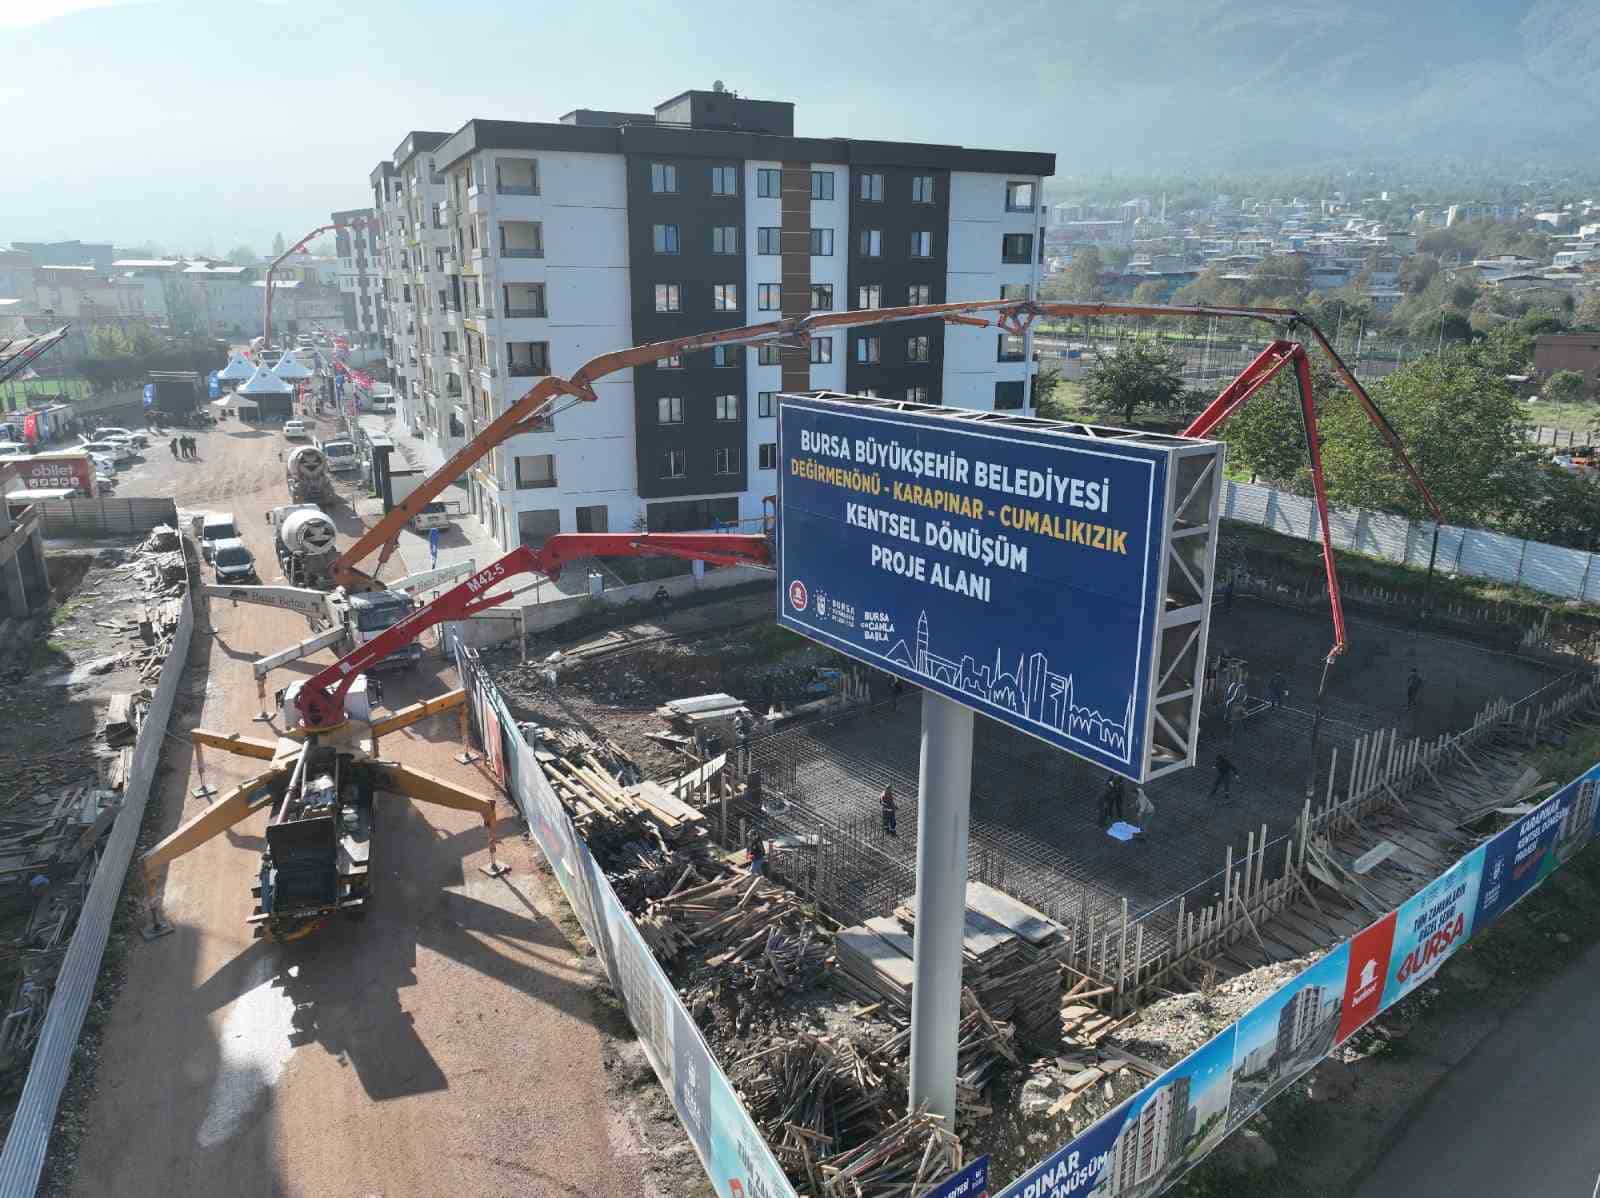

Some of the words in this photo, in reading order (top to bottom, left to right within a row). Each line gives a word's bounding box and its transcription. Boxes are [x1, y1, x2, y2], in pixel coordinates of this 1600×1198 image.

[31, 463, 73, 477] obilet
[801, 429, 850, 460] BURSA
[855, 436, 968, 485] BÜYÜKŞEHİR
[975, 461, 1109, 513] BELEDİYESİ
[791, 458, 880, 496] DEĞİRMENÖNÜ
[894, 480, 983, 520] KARAPINAR
[1000, 504, 1128, 555] CUMALIKIZIK
[846, 502, 920, 543] KENTSEL
[926, 520, 1028, 573] DÖNÜŞÜM
[872, 544, 925, 582] PROJE
[930, 562, 990, 603] ALANI
[864, 611, 889, 623] BURSA
[1013, 1149, 1080, 1198] PINAR
[1050, 1150, 1109, 1198] ÖNÜŞÜM
